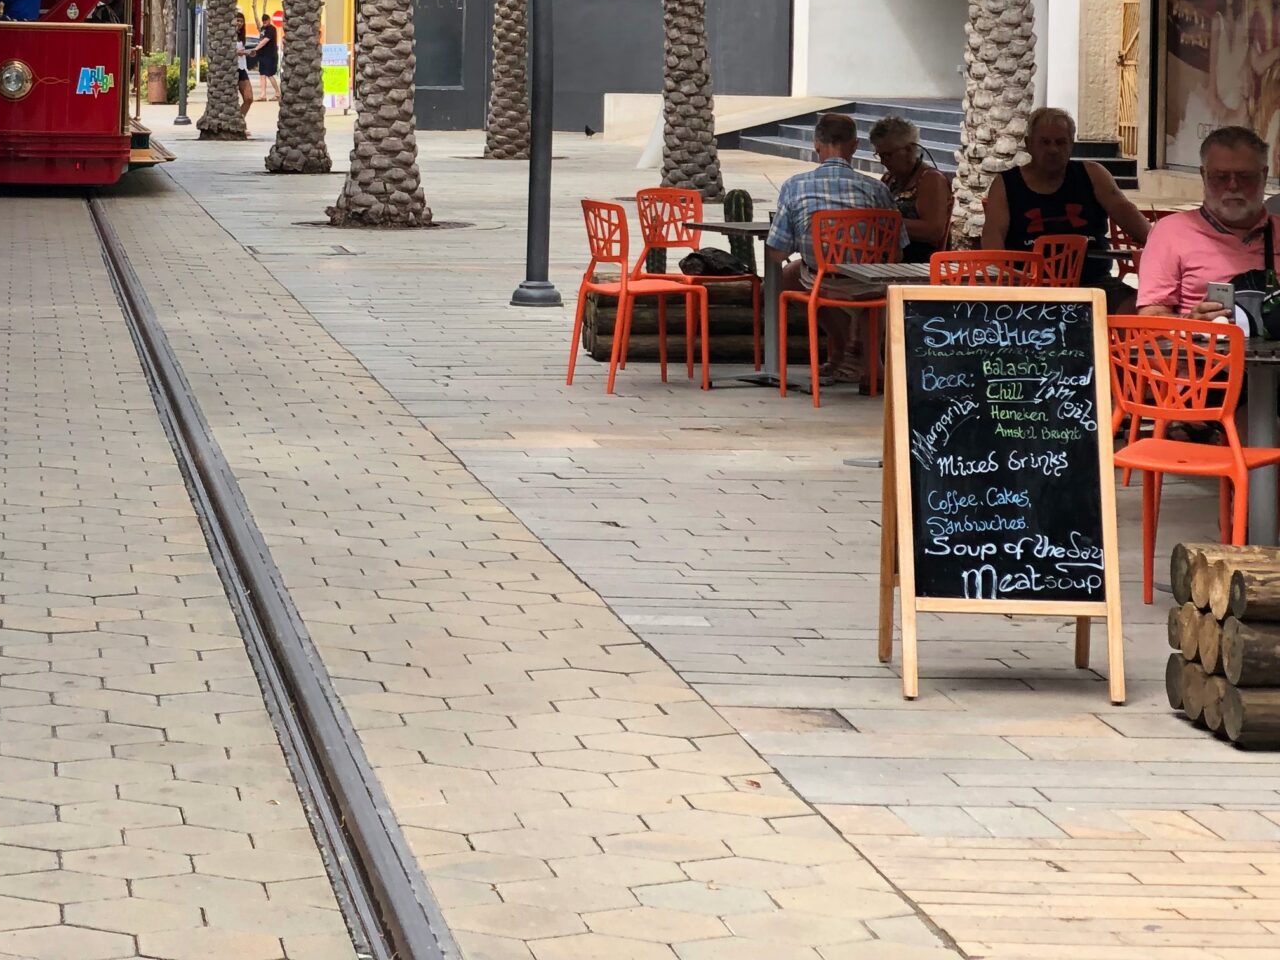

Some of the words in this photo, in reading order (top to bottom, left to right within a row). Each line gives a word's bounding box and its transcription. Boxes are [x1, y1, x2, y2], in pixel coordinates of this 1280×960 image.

[76, 66, 115, 95] ARUBA
[922, 316, 1068, 350] Smoothies!
[1057, 366, 1094, 386] Local
[986, 382, 1024, 401] Chill
[937, 450, 1000, 478] Mixed
[1008, 450, 1069, 477] drinks
[925, 536, 998, 561] Soup
[1004, 537, 1034, 560] of
[1033, 534, 1066, 559] the
[1066, 531, 1106, 566] day
[962, 564, 1044, 600] Meat
[1045, 574, 1102, 595] soup
